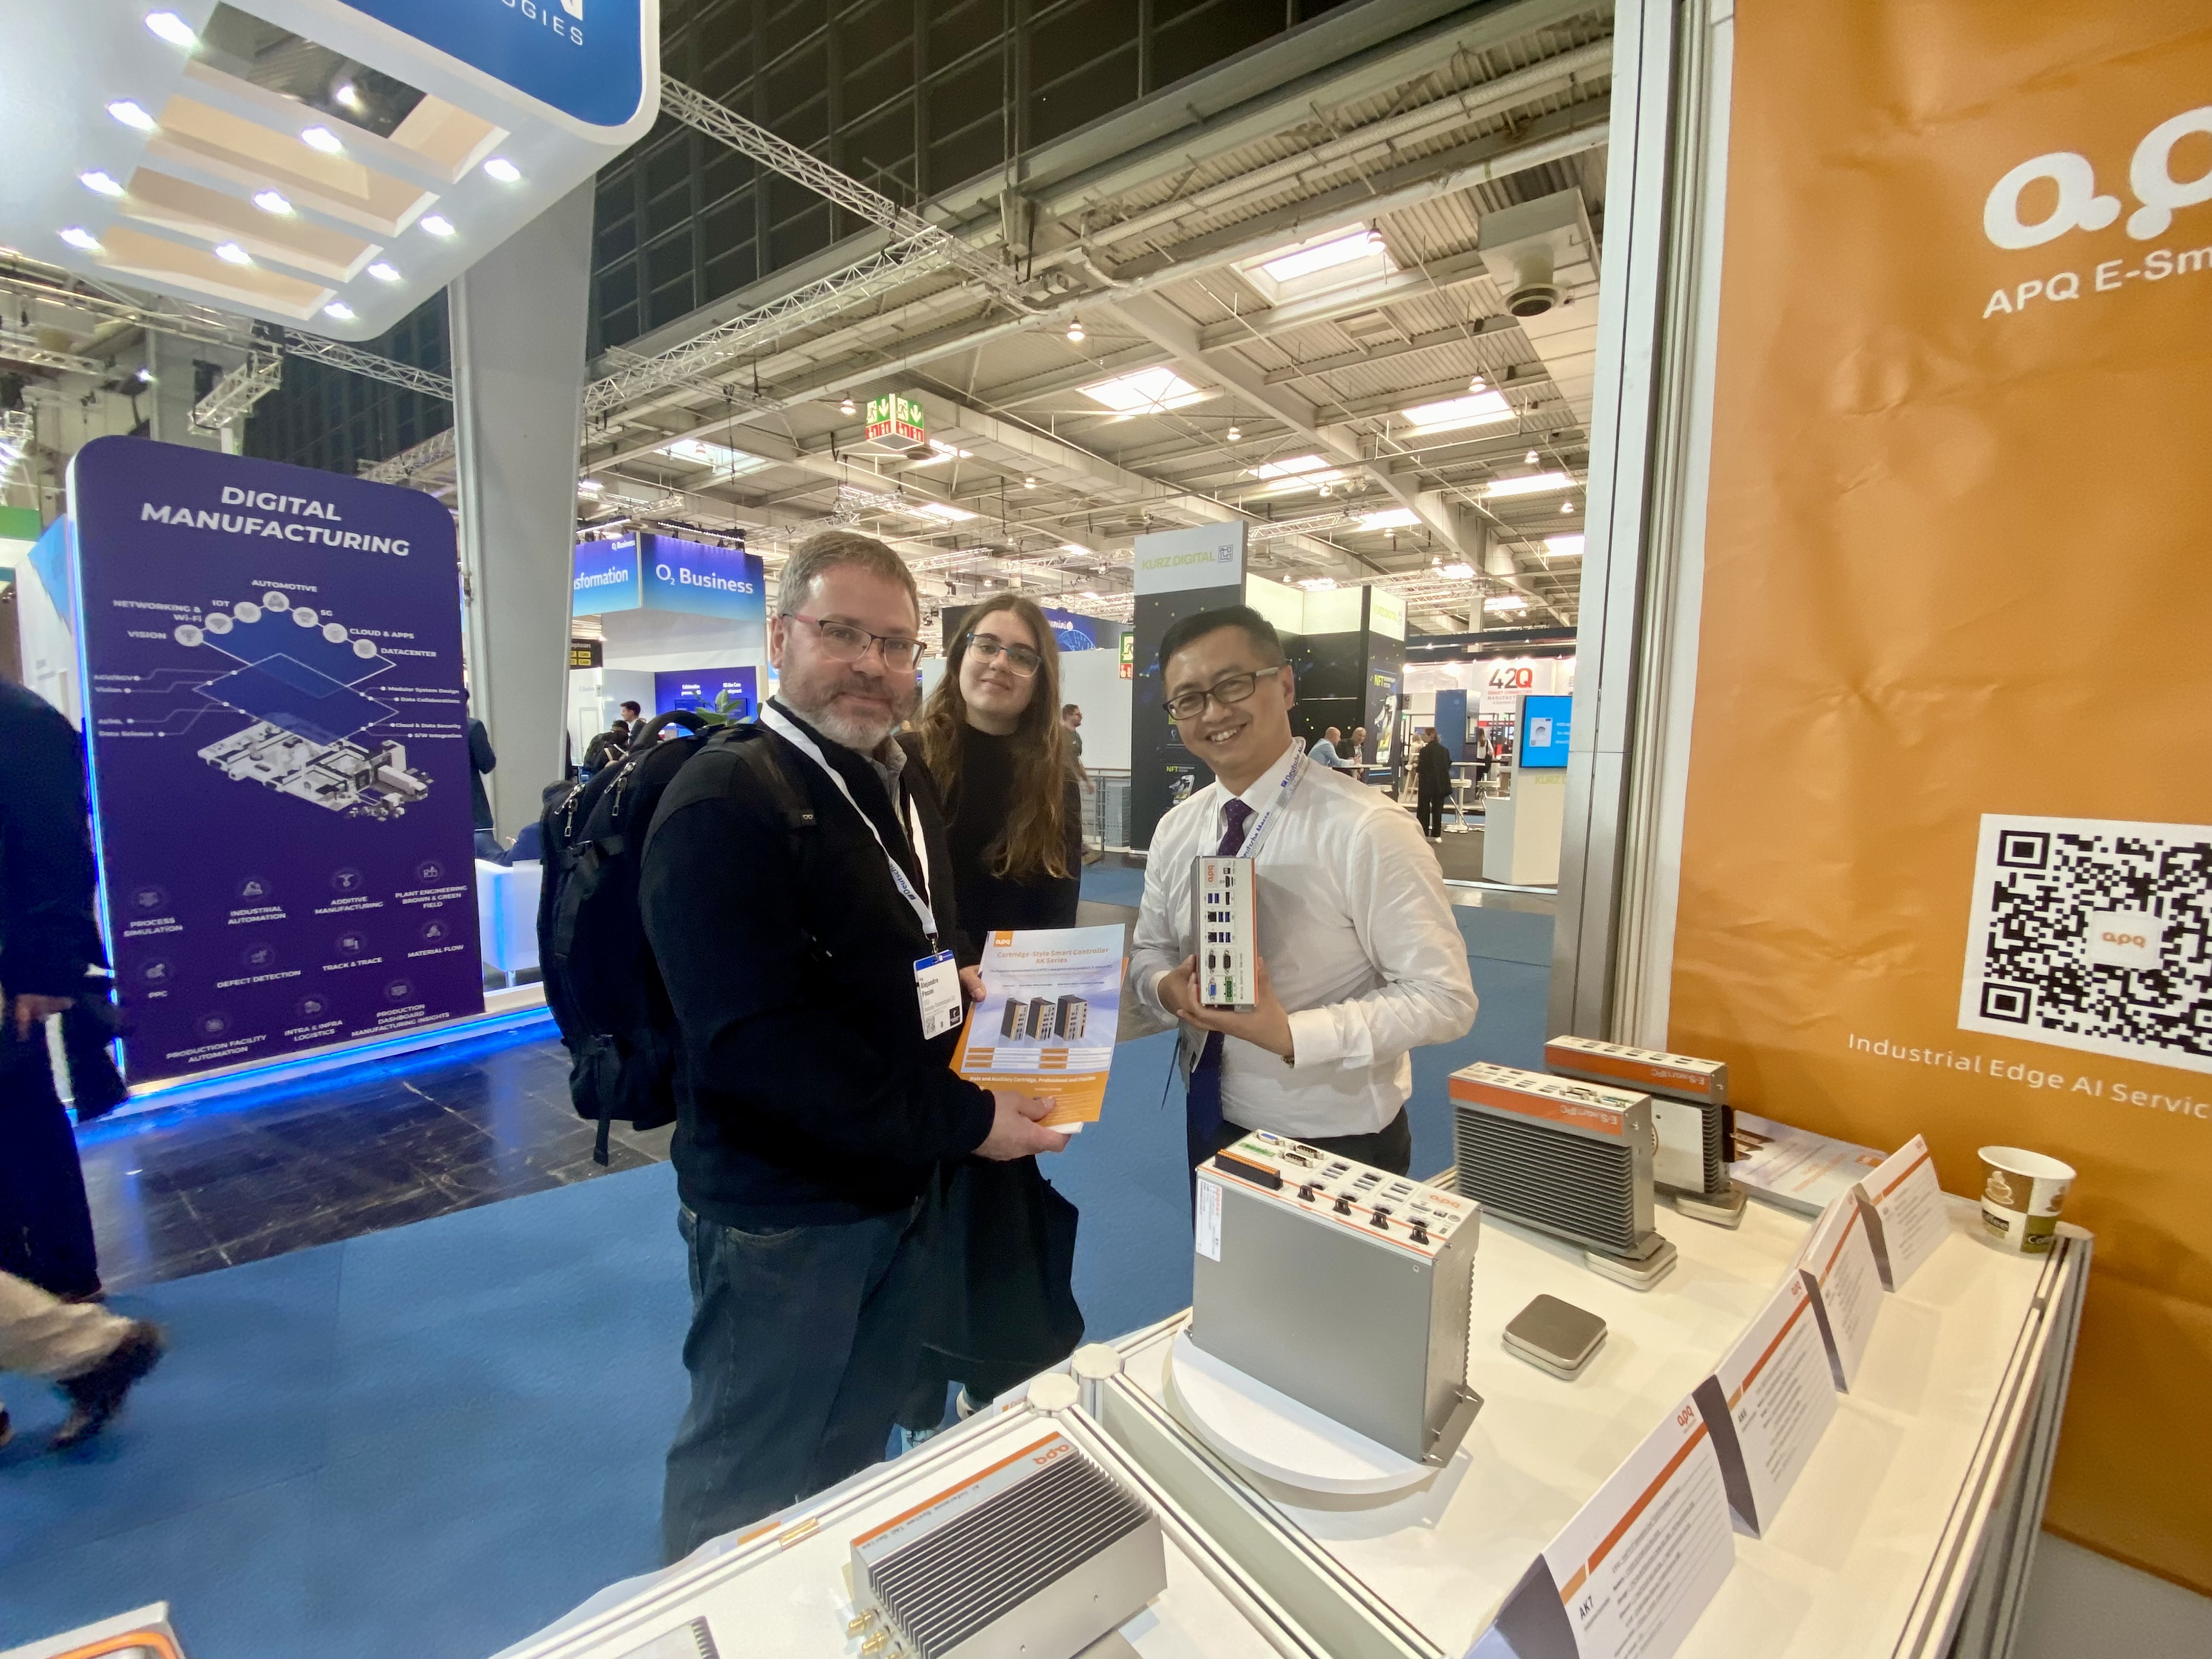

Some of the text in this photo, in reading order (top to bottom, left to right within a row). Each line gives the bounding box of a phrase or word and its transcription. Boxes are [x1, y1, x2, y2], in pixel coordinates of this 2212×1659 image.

[1982, 272, 2080, 319] APQ
[221, 486, 341, 521] DIGITAL
[140, 503, 410, 556] MANUFACTURING
[617, 539, 635, 549] Business
[1142, 551, 1216, 570] KURZ DIGITAL
[251, 579, 318, 592] AUTOMOTIVE
[679, 567, 754, 594] Business
[113, 600, 191, 612] NETWORKING
[173, 613, 202, 623] Wi-Fi
[127, 630, 166, 639] VISION
[349, 628, 381, 636] CLOUD
[391, 631, 415, 640] APPS
[381, 648, 437, 658] DATACENTER
[1488, 668, 1533, 689] 42Q
[1285, 753, 1301, 781] Deutsche
[395, 885, 467, 898] PLANT ENGINEERING
[402, 896, 431, 905] BROWN
[437, 892, 461, 901] GREEN
[330, 896, 368, 905] ADDITIVE
[230, 906, 283, 917] INDUSTRIAL
[314, 901, 383, 915] MANUFACTURING
[129, 917, 176, 928] PROCESS
[228, 913, 286, 925] AUTOMATION
[123, 925, 183, 938] SIMULATION
[2102, 932, 2146, 948] apq
[408, 944, 464, 958] MATERIAL FLOW
[323, 962, 349, 971] TRACK
[357, 957, 382, 966] TRACE
[217, 970, 301, 989] DEFECT DETECTION
[376, 1004, 426, 1018] PRODUCTION
[378, 1011, 425, 1025] DASHBOARD
[284, 1028, 311, 1036] INTRA
[318, 1020, 343, 1029] INFRA
[351, 1012, 450, 1037] MANUFACTURING INSIGHTS
[294, 1028, 336, 1042] LOGISTICS
[166, 1034, 268, 1060] PRODUCTION FACILITY
[188, 1046, 249, 1063] AUTOMATION
[1848, 1034, 2212, 1120] Industrial Edge AI Servic
[1429, 1194, 1461, 1209] apq
[1677, 1404, 1695, 1426] apq
[1032, 1443, 1069, 1465] apq
[1579, 1595, 1595, 1621] AK7
